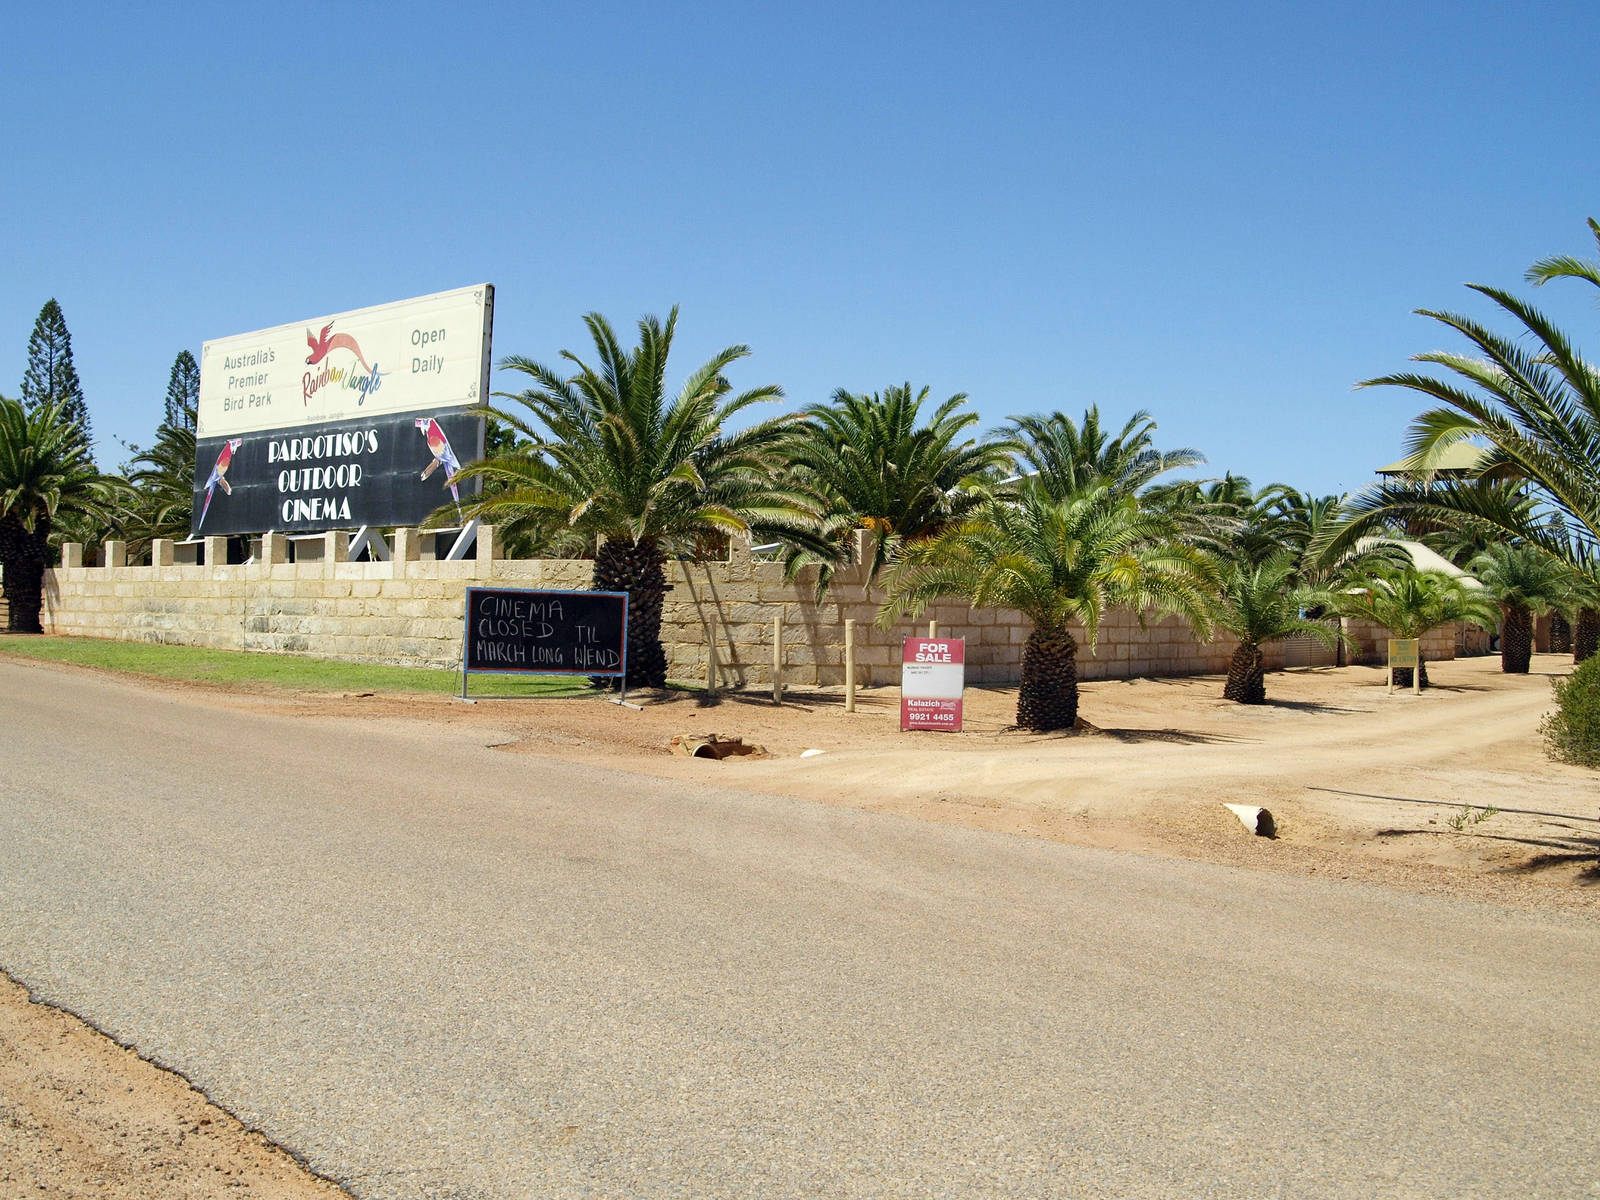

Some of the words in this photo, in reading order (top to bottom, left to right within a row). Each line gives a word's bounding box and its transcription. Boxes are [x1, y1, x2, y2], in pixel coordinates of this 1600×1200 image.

[411, 329, 446, 349] Open
[223, 346, 276, 370] Australia's
[411, 354, 445, 374] Daily
[228, 371, 269, 390] Premier
[302, 356, 345, 407] Rainbow
[342, 359, 382, 407] Jungle
[223, 395, 244, 412] Bird
[248, 391, 272, 408] Park
[268, 429, 379, 463] PARROTISO'S
[278, 463, 362, 493] OUTDOOR
[282, 496, 352, 522] CINEMA
[479, 596, 563, 621] CINEMA
[478, 618, 554, 638] CLOSED
[575, 625, 600, 643] TIL
[476, 639, 526, 663] MARCH
[532, 645, 563, 665] LONG
[915, 653, 952, 663] SALE
[919, 643, 948, 653] FOR
[907, 699, 940, 707] Kalazich
[933, 713, 954, 721] 4455
